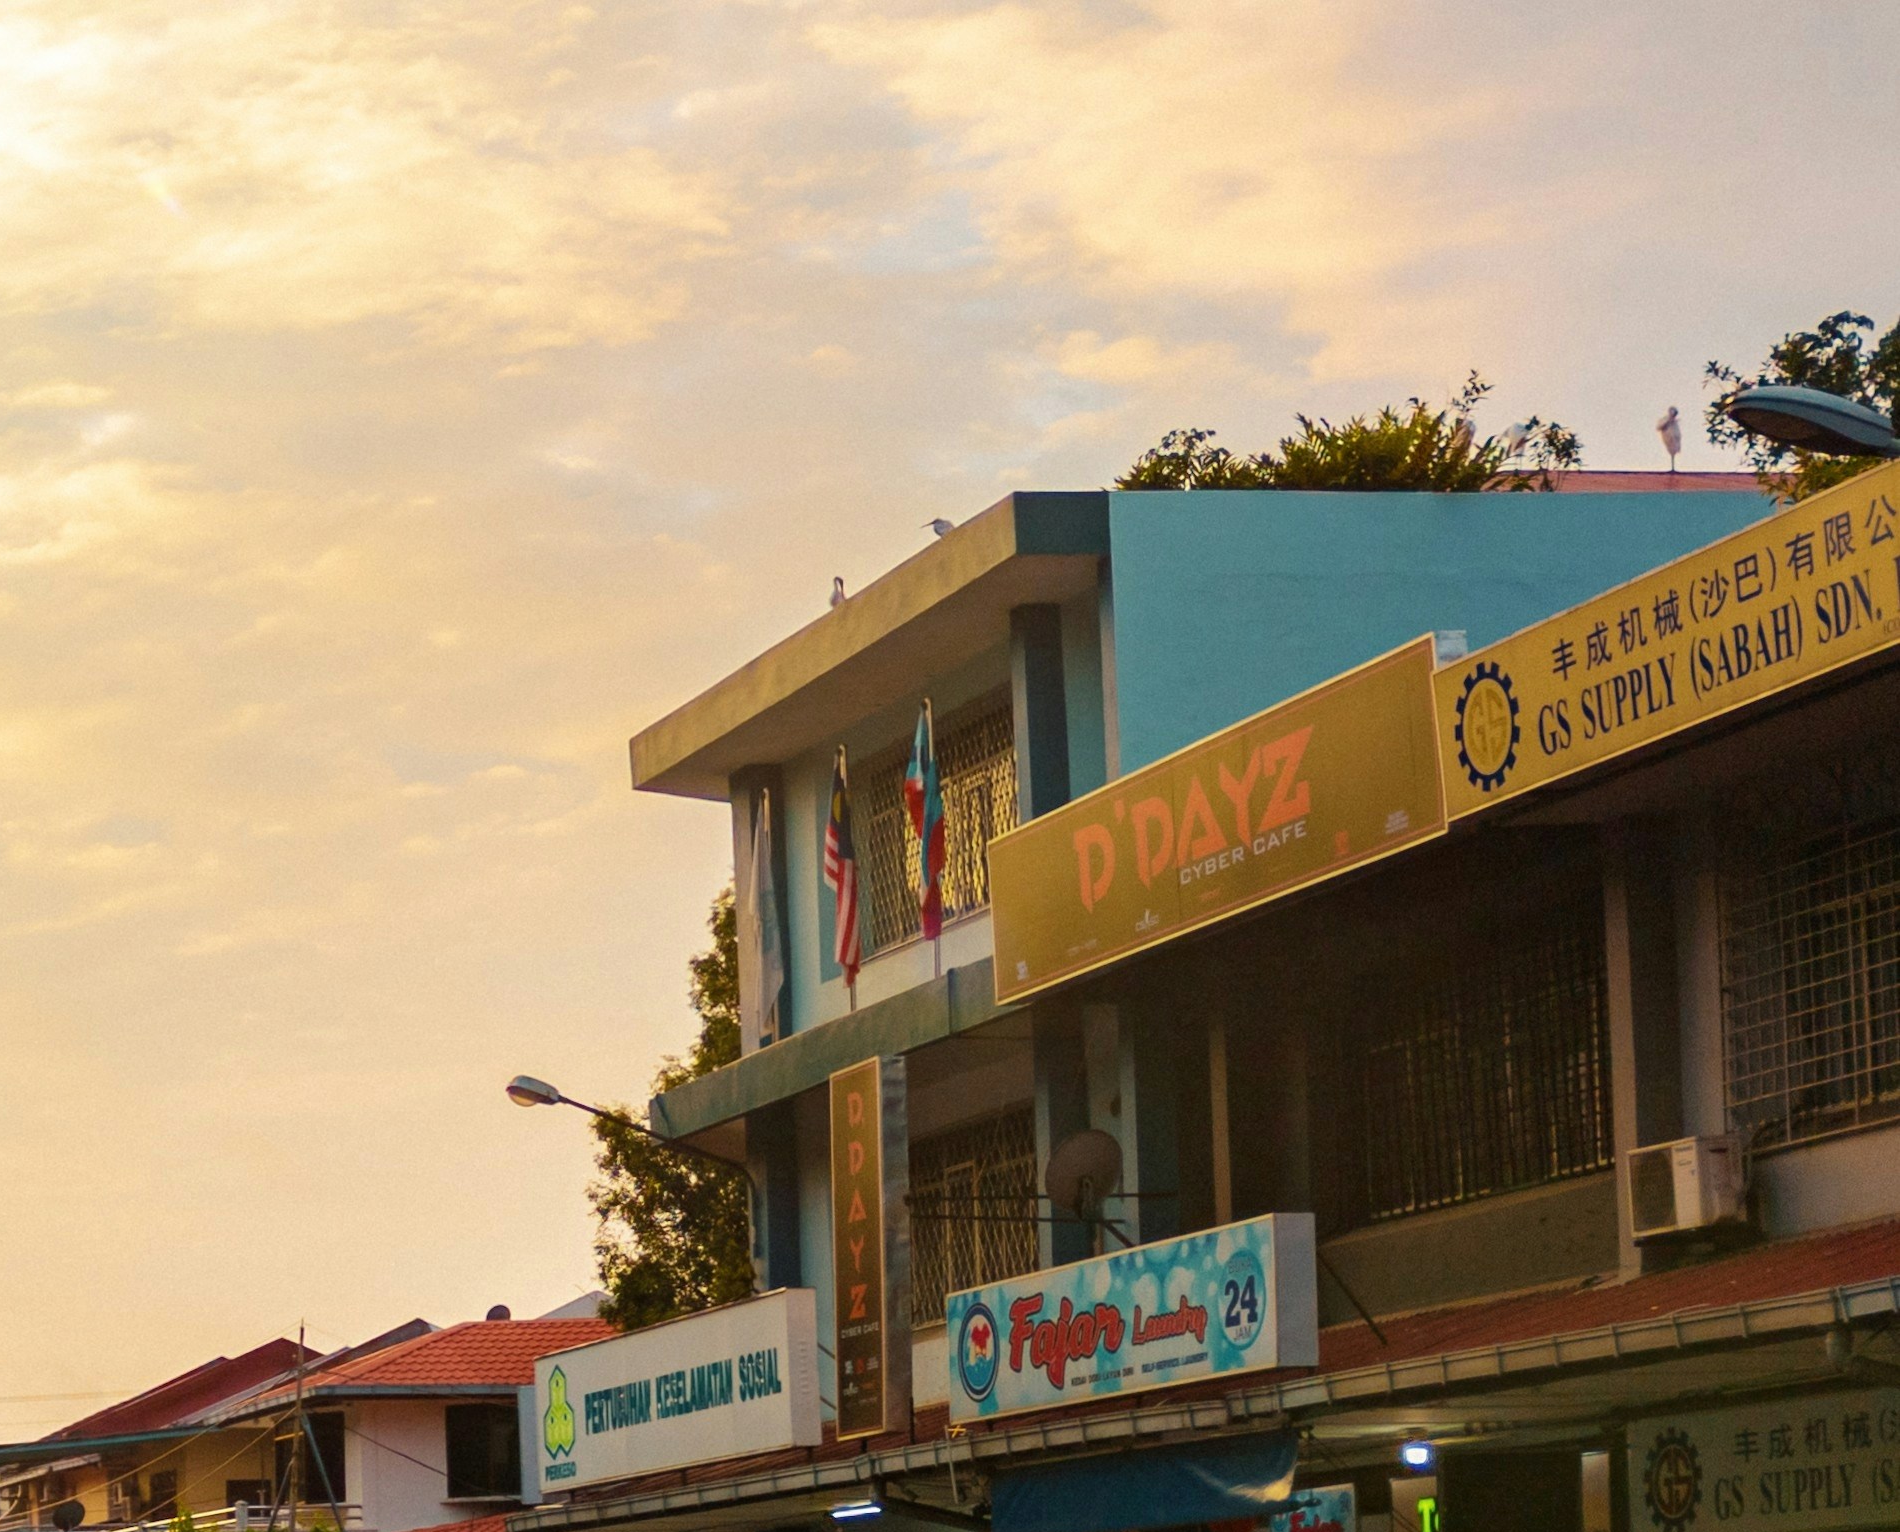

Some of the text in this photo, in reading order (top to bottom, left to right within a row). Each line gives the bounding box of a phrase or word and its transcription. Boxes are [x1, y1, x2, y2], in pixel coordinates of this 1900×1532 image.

[1537, 700, 1572, 756] GS
[1582, 652, 1678, 742] SUPPLY
[1689, 594, 1803, 700] (SABAH)
[1815, 568, 1883, 645] SDN.
[1073, 724, 1315, 914] D'DAYZ
[1179, 819, 1308, 886] CYBER CAFE
[841, 1320, 880, 1339] CYBER CAFE
[1224, 1274, 1258, 1328] 24
[1233, 1325, 1252, 1342] JAM
[1008, 1292, 1209, 1390] Fajar Laundry
[584, 1347, 782, 1436] PERTUBUHAN KESELAMATAN SOSIAL
[1714, 1475, 1745, 1520] GS
[1759, 1462, 1856, 1516] SUPPLY
